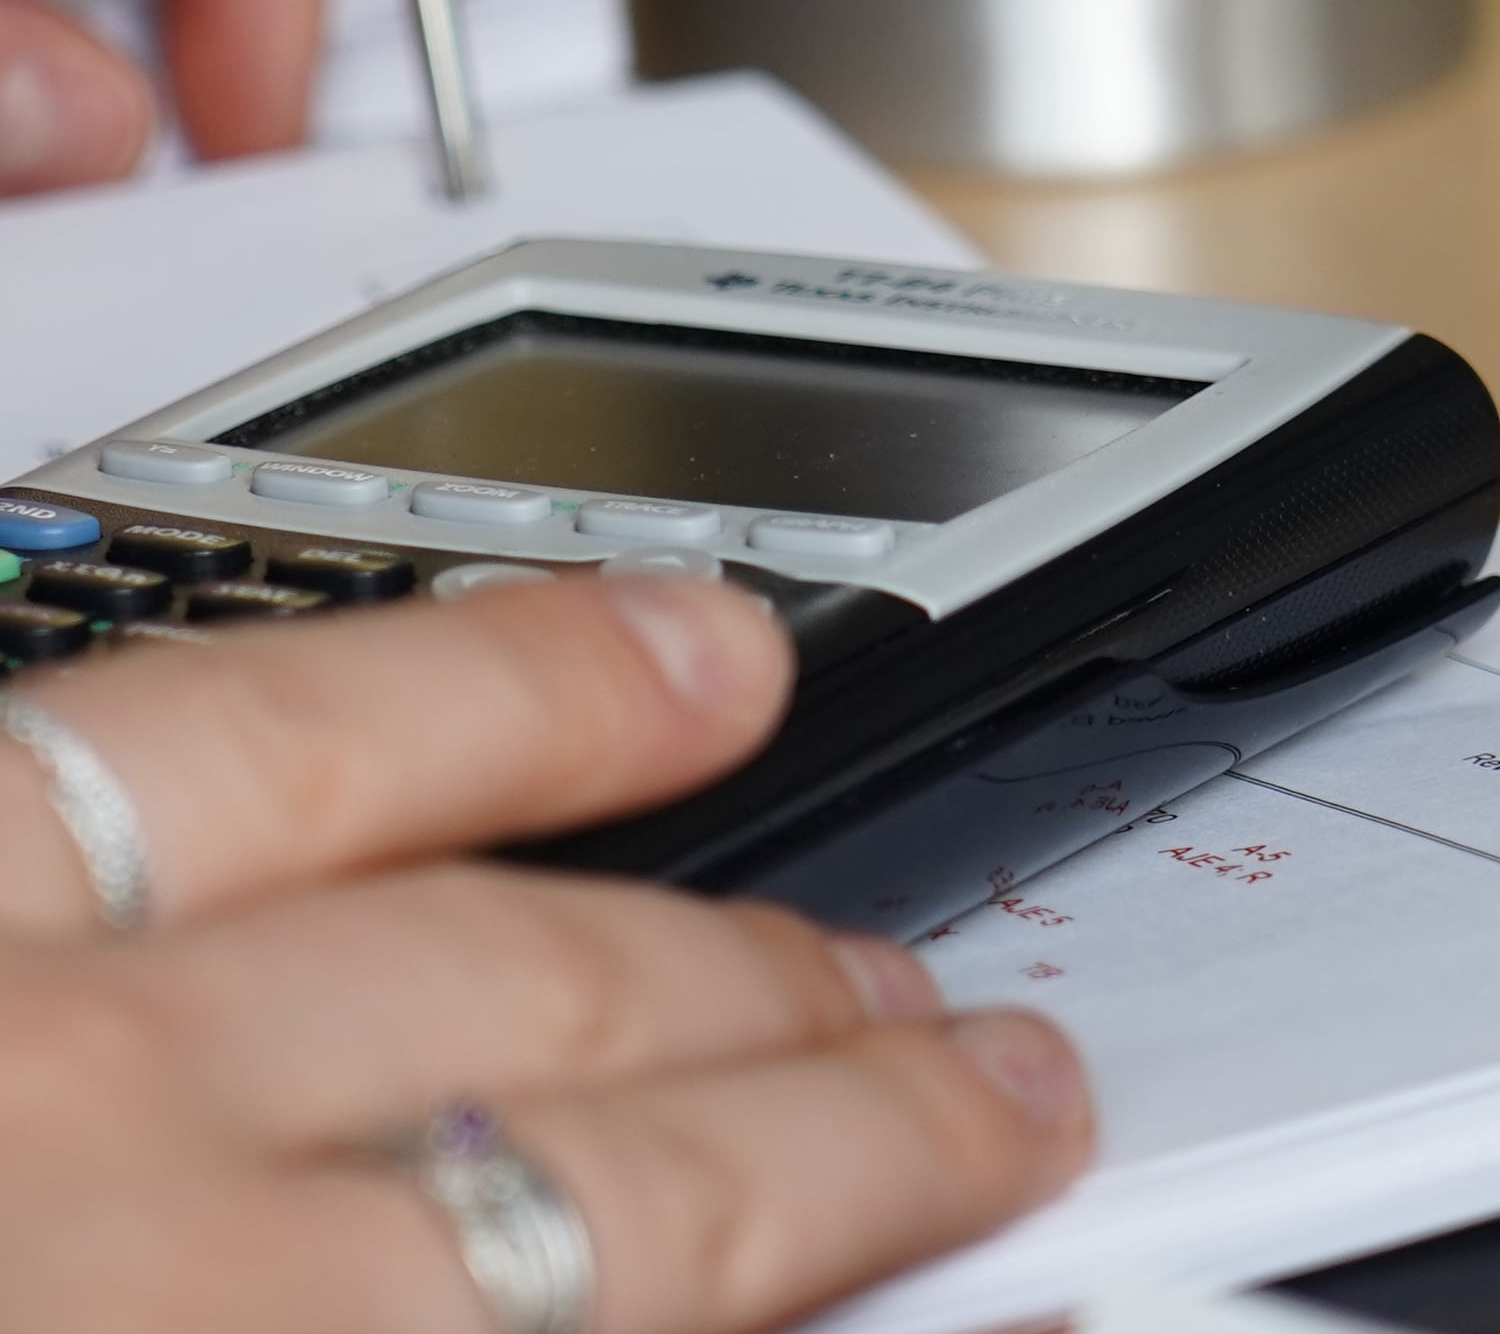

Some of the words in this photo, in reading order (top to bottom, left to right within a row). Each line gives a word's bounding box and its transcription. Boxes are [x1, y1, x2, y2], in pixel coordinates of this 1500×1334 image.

[261, 461, 375, 483] WINDOW
[434, 481, 522, 499] ZOOM
[603, 499, 691, 517] TRACE
[122, 524, 226, 545] MODE
[296, 548, 363, 564] DEL
[1231, 843, 1293, 864] A-5
[1157, 845, 1227, 870] AJE
[1235, 870, 1275, 886] R
[985, 897, 1056, 921] AJE
